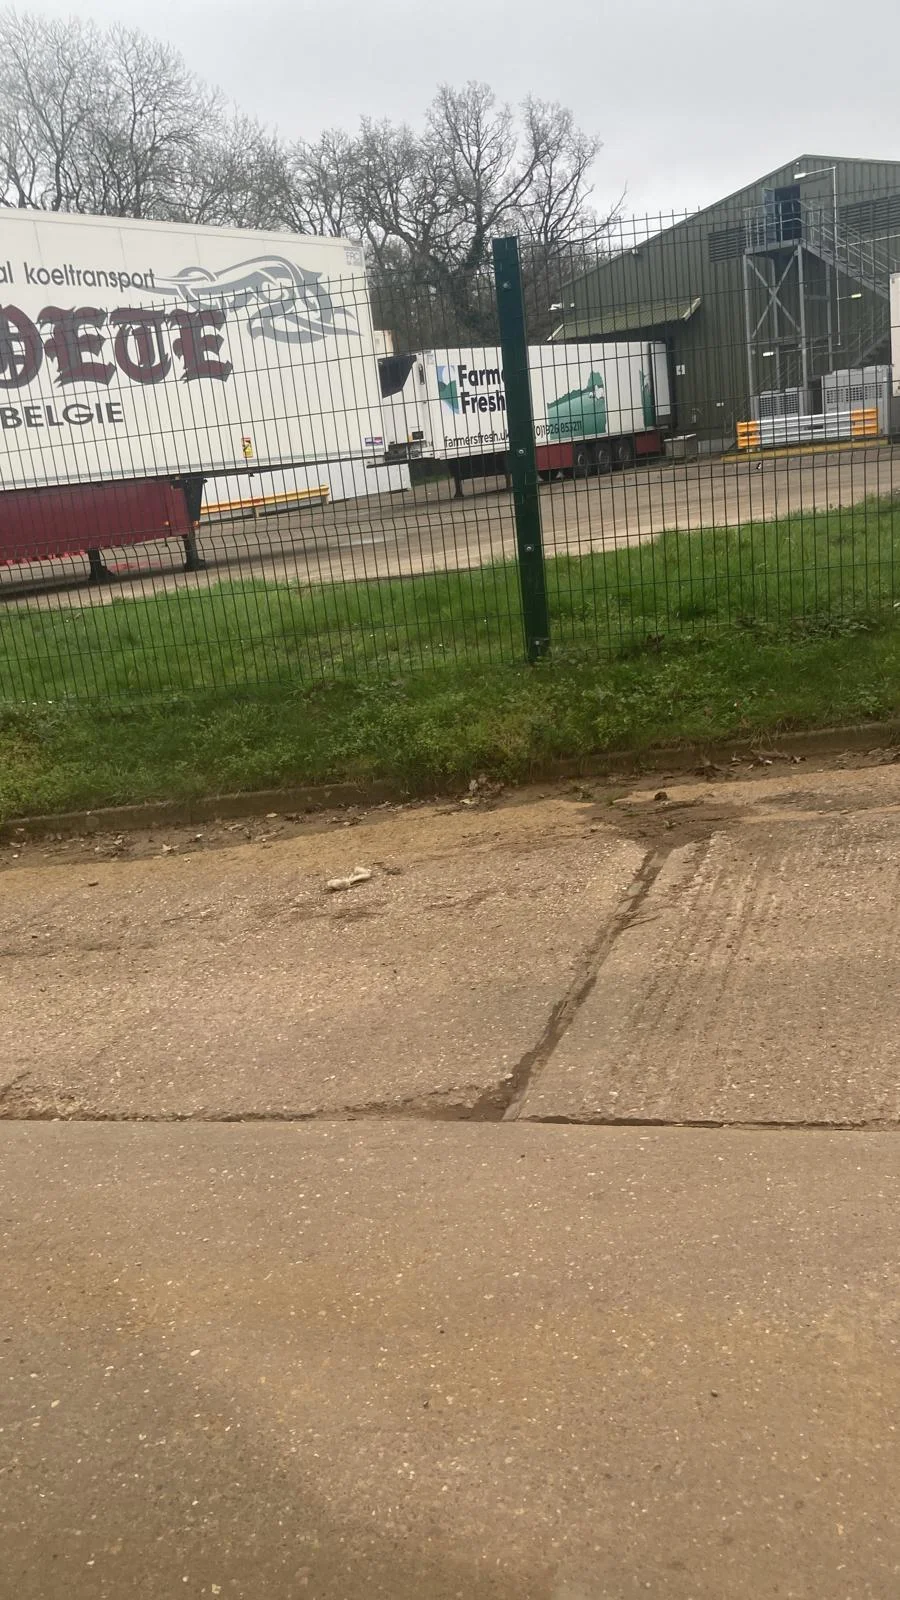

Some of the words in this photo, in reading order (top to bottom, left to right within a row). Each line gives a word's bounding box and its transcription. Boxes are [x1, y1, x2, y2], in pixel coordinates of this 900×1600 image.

[24, 262, 155, 292] koeltransport
[458, 365, 505, 387] Farm
[461, 390, 506, 414] Fresh
[0, 402, 124, 429] BELGIE
